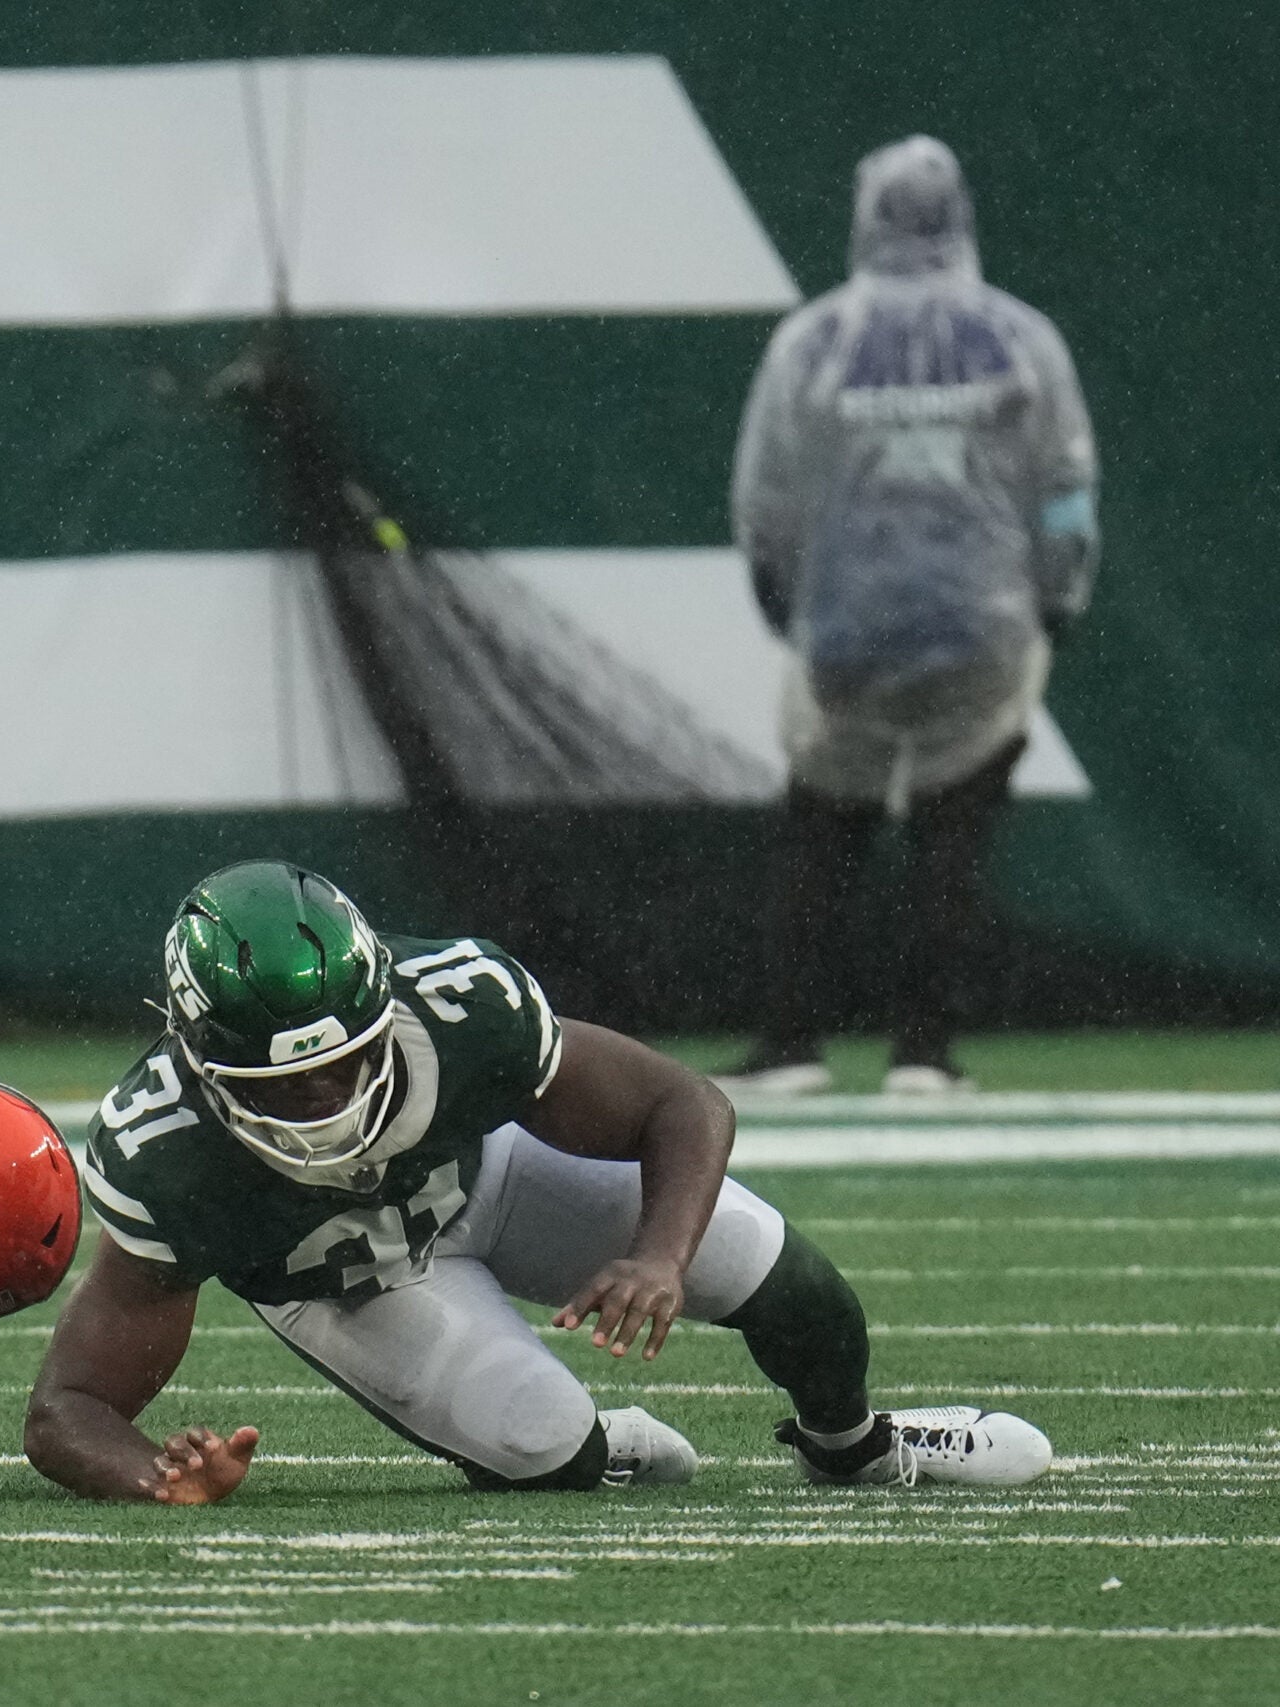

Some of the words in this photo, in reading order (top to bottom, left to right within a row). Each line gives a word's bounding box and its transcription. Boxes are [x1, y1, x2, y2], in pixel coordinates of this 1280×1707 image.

[395, 939, 521, 1023] 31
[292, 1030, 327, 1054] NY
[100, 1054, 200, 1160] 31
